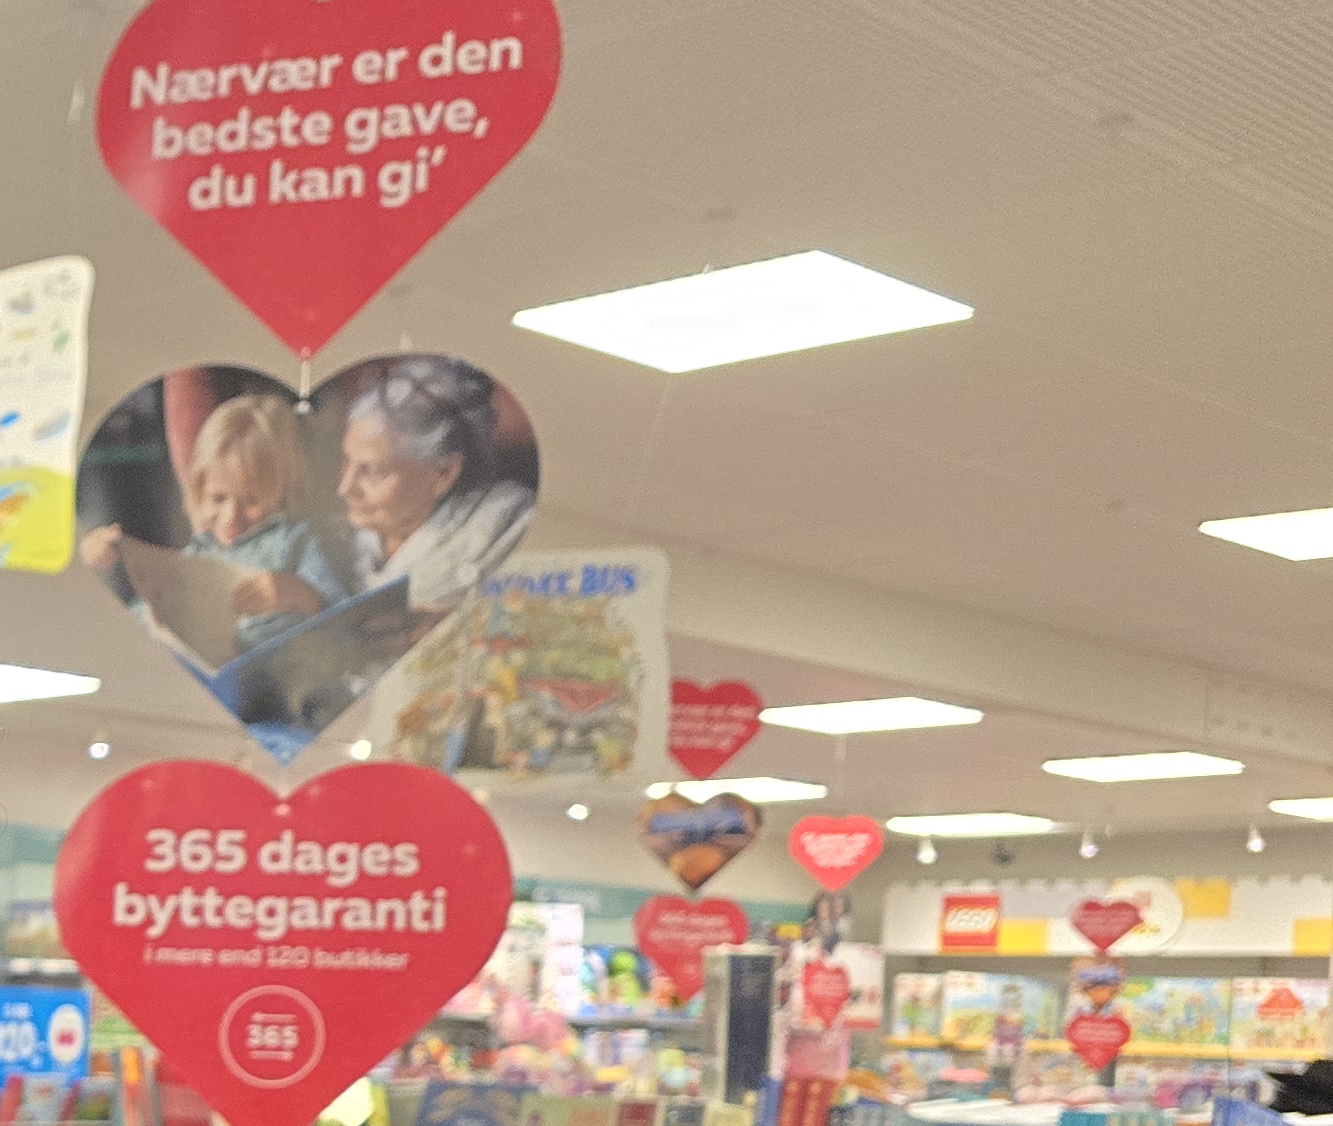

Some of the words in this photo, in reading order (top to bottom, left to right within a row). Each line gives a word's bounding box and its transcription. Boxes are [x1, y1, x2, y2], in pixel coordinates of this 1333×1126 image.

[130, 55, 343, 109] Nærvær
[352, 47, 408, 84] er
[418, 31, 523, 79] den
[151, 106, 331, 159] bedste
[345, 98, 489, 155] gave,
[188, 164, 256, 210] du
[269, 158, 364, 204] kan
[144, 828, 247, 874] 365
[259, 831, 420, 885] dages
[112, 882, 448, 941] byttegaranti
[946, 908, 996, 931] LEGO
[155, 948, 213, 965] mere
[219, 946, 262, 965] end
[267, 945, 309, 966] 120
[314, 947, 410, 970] butikker
[245, 1022, 299, 1050] 365
